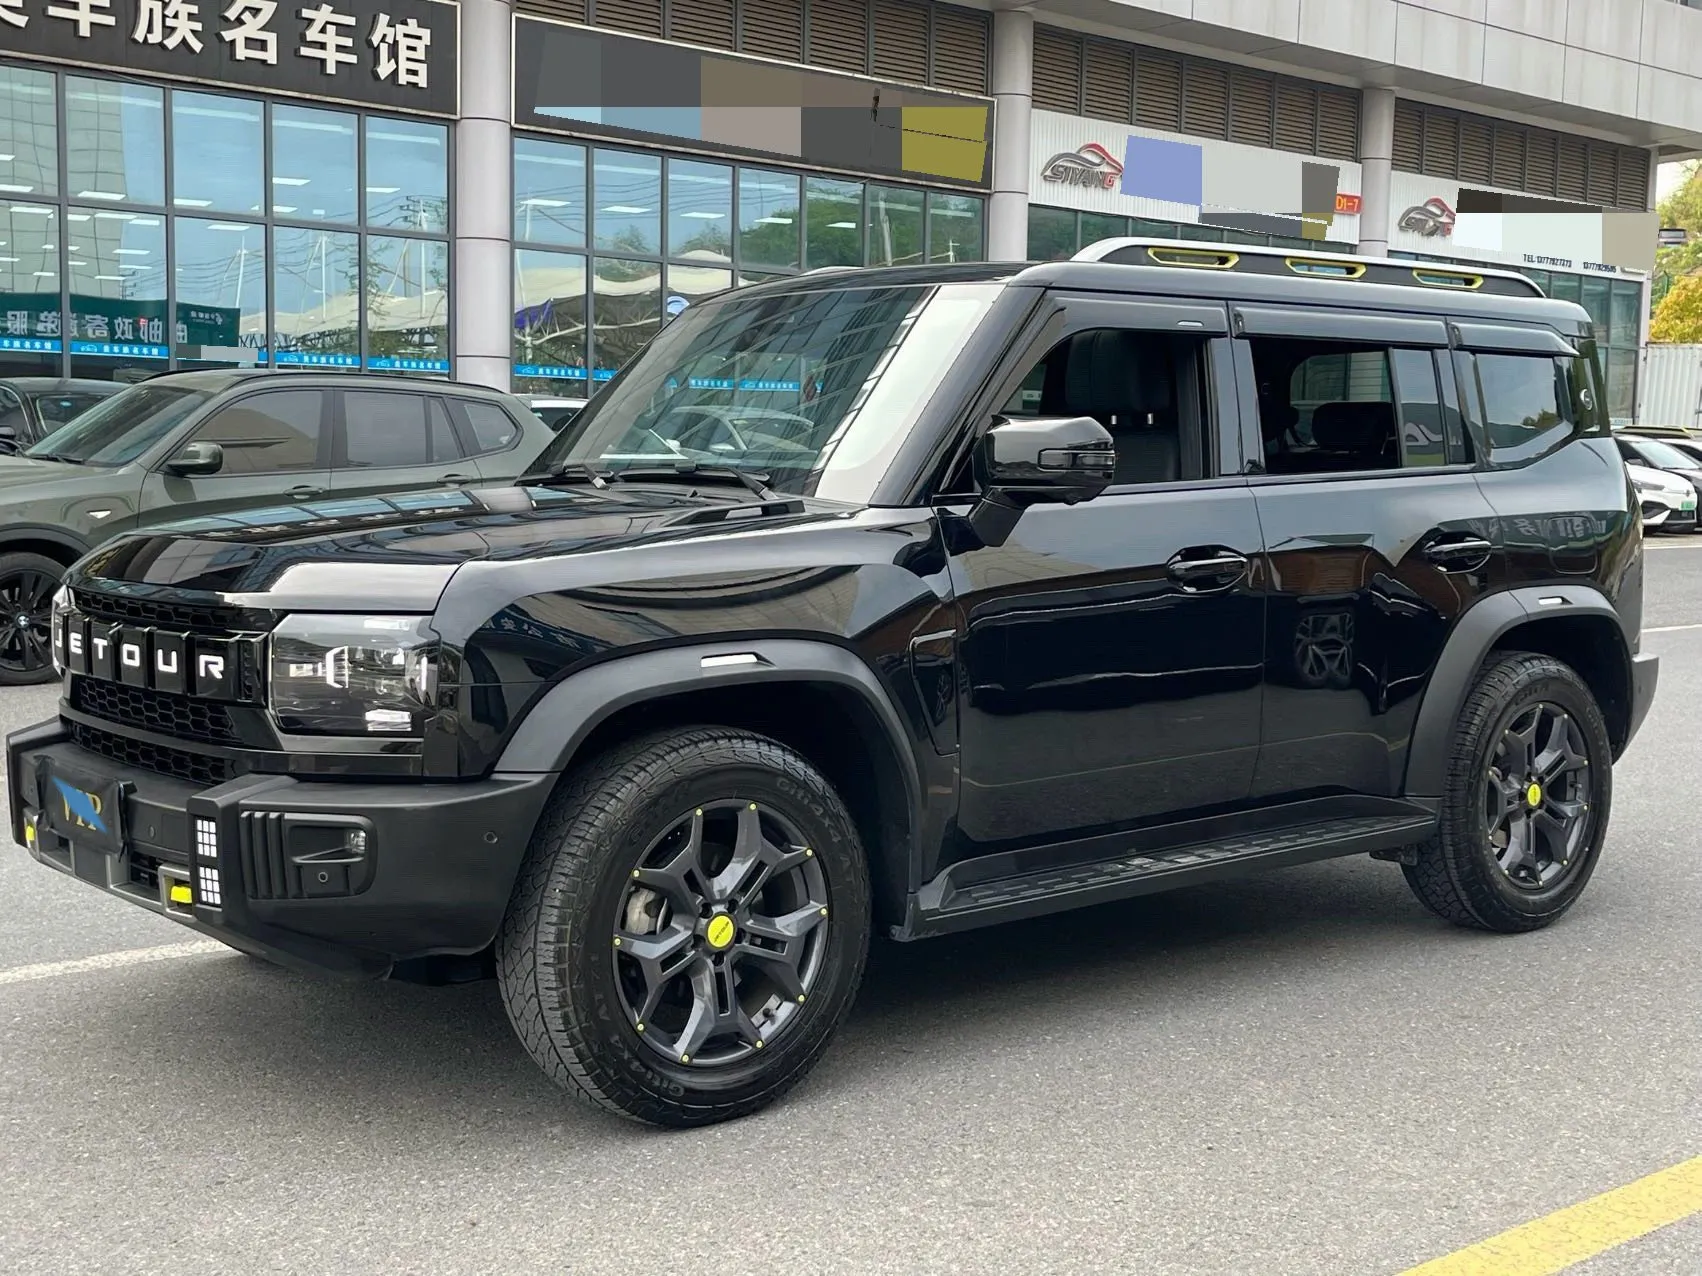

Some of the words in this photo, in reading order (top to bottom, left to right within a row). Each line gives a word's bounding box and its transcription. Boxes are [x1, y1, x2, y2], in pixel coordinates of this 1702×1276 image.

[0, 0, 431, 89] 车族名车馆
[1043, 163, 1120, 189] SIYANG
[1336, 195, 1359, 212] D1-7
[55, 632, 225, 679] JETOUR
